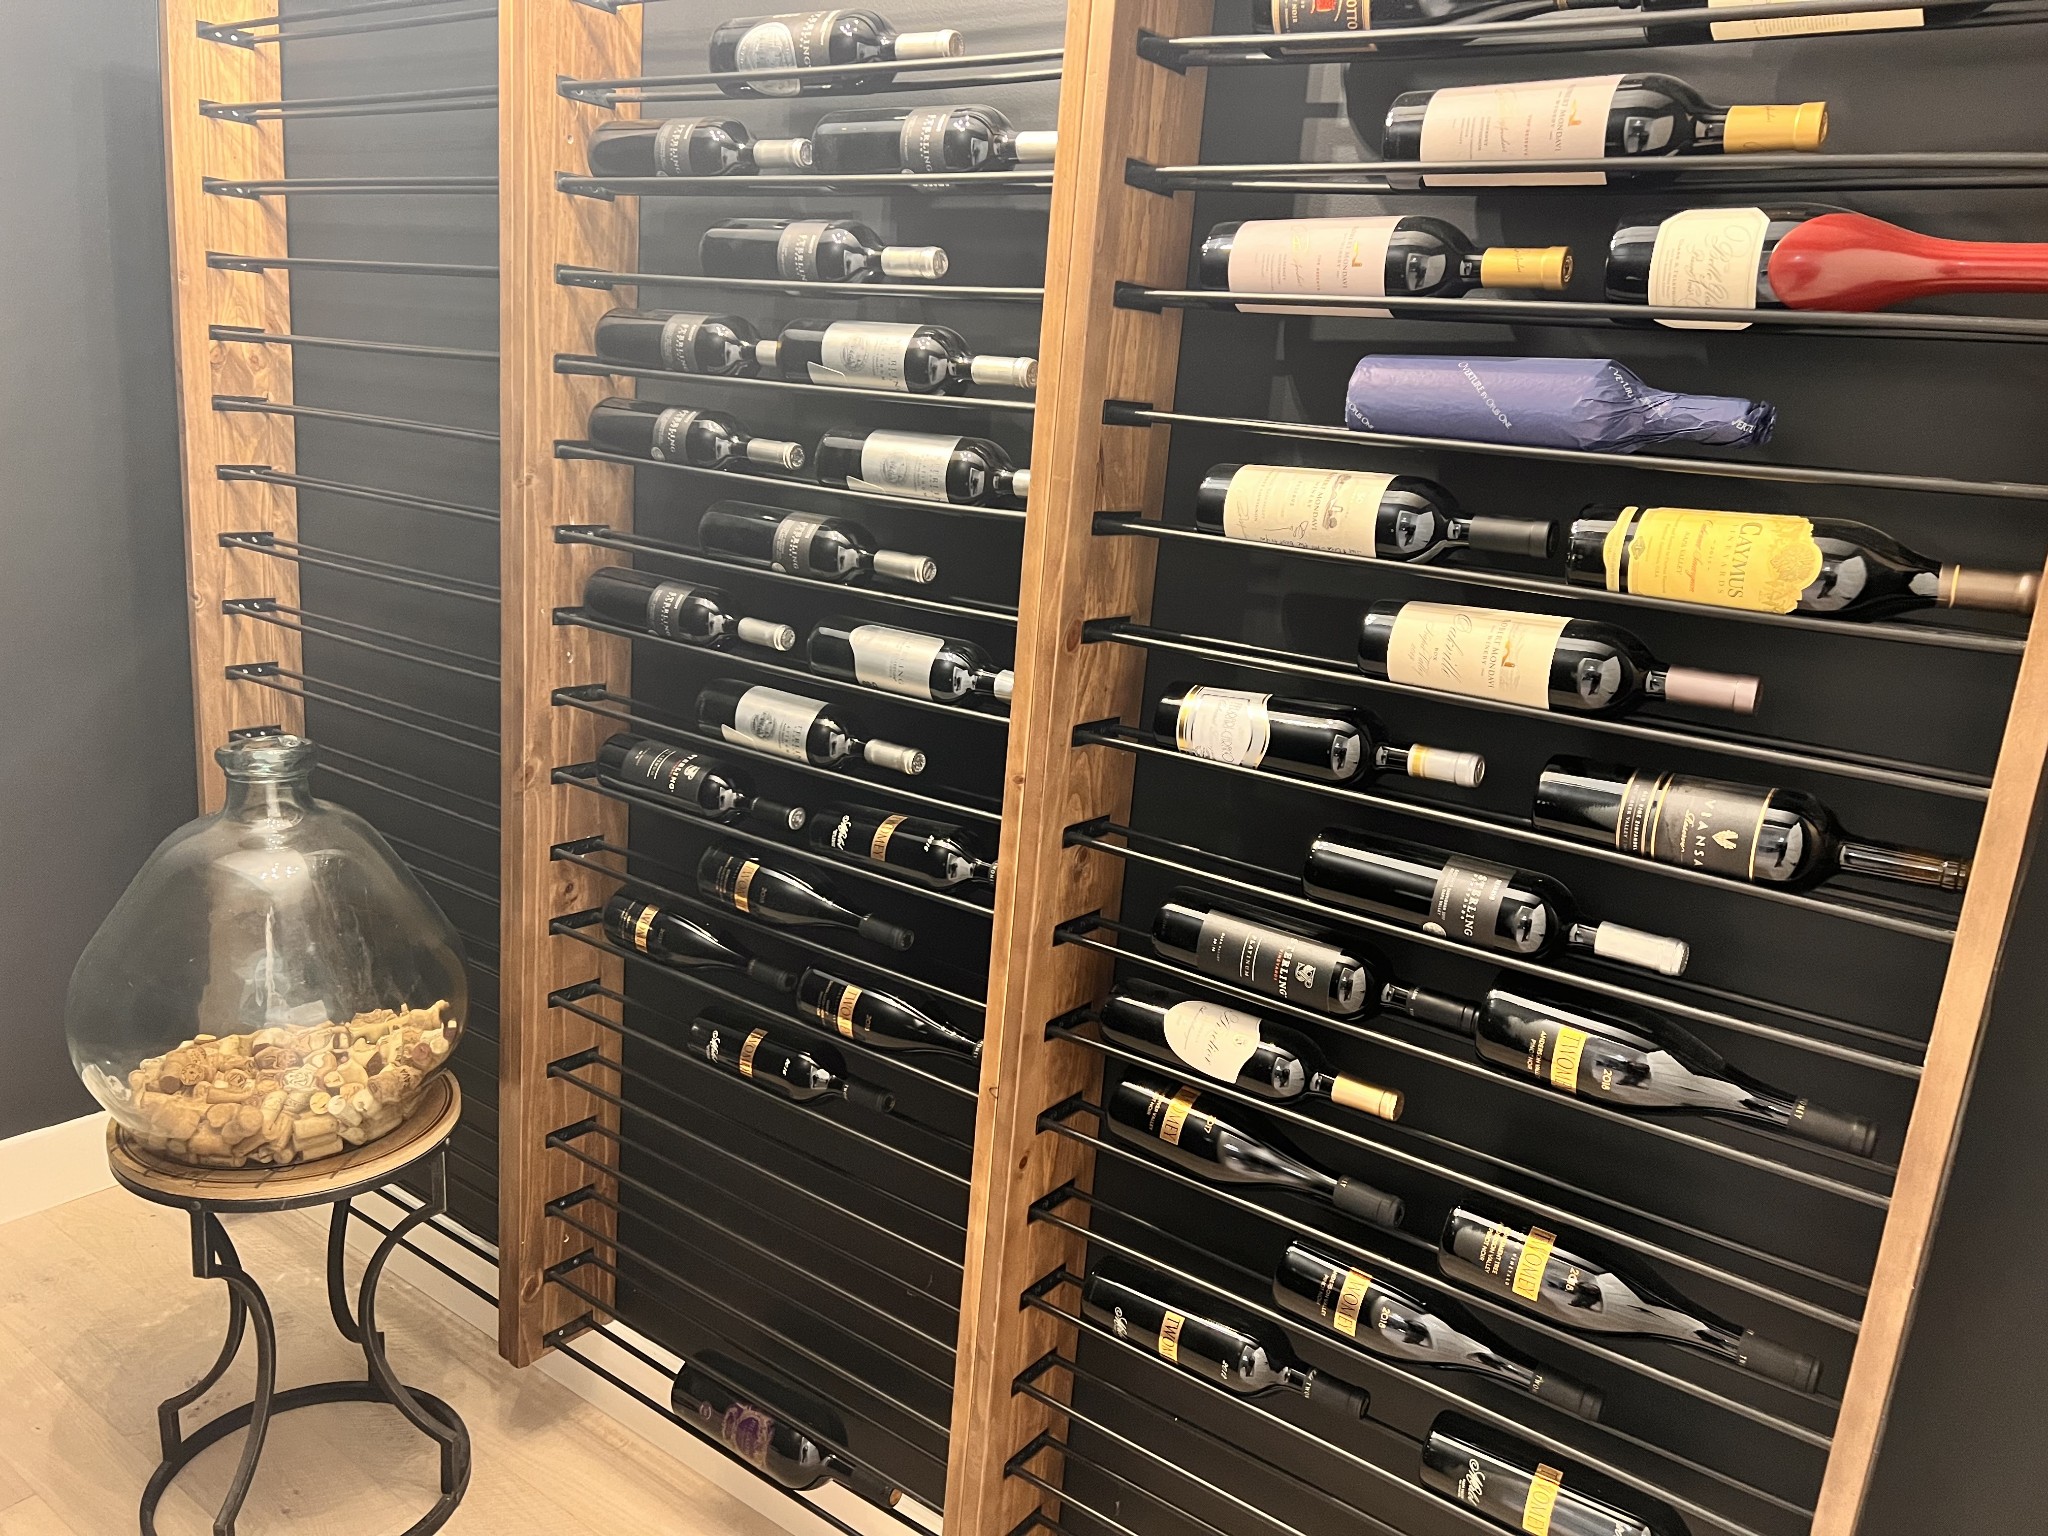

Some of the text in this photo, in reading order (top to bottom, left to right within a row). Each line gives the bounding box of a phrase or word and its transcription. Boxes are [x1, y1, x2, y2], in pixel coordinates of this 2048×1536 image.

[1554, 109, 1567, 152] MONDAVI
[796, 234, 808, 282] STERLIN
[1341, 252, 1351, 289] MONDAVI
[1457, 361, 1485, 393] OVERTURE
[1485, 398, 1502, 416] OPUS
[1498, 414, 1513, 430] ONE
[1348, 402, 1374, 430] OPUS ONE
[1306, 480, 1320, 509] WINERY
[1311, 492, 1324, 531] MONDAVI
[1675, 549, 1686, 576] VALLEY
[1717, 524, 1739, 595] VINEYARDS
[1726, 522, 1764, 599] CAYMUS
[1440, 613, 1473, 683] Oakville
[1481, 635, 1493, 666] WINERY
[1487, 619, 1512, 689] ROBERT MONDAVI
[669, 754, 697, 790] STERLING
[1623, 816, 1632, 839] VALLEY
[1632, 820, 1642, 852] ZINFANDEL
[1679, 809, 1696, 853] Reserve
[1693, 799, 1717, 867] VIANSA
[1463, 874, 1488, 937] STERLING
[1243, 934, 1258, 978] PLATINUM
[1272, 948, 1284, 982] VINEYARDS
[1278, 936, 1299, 999] STERLING
[1600, 1068, 1613, 1091] 2018
[1148, 1112, 1158, 1131] VALLEY
[1479, 1227, 1494, 1262] PINOT NOIR
[1484, 1253, 1495, 1274] VALLEY
[1491, 1261, 1502, 1281] TREE
[1517, 1232, 1552, 1298] TWOMEY
[1320, 1298, 1330, 1317] VALLEY
[1378, 1306, 1391, 1329] 2018
